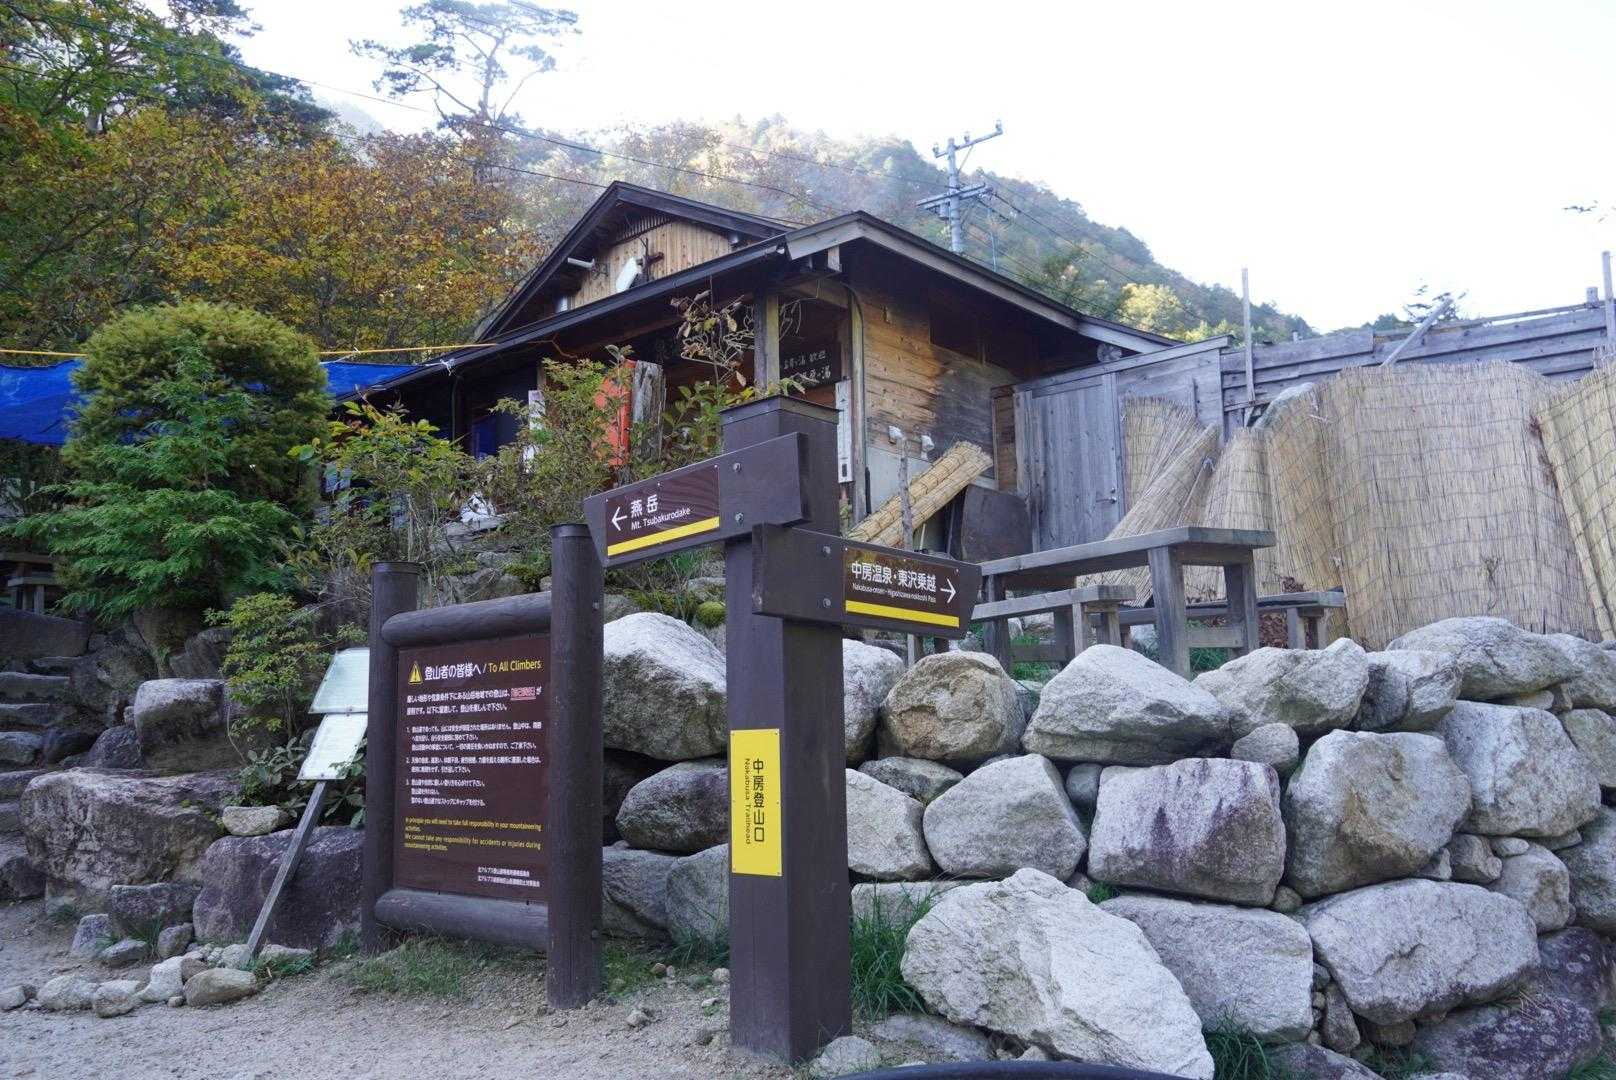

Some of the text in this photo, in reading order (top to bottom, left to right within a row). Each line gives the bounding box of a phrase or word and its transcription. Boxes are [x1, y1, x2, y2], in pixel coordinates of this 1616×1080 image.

[631, 494, 658, 518] 燕岳
[631, 508, 691, 531] Mt. Tsubakurodake
[488, 662, 498, 672] To
[499, 661, 509, 672] All
[510, 659, 542, 672] Climbers
[753, 758, 765, 842] 中房登山口
